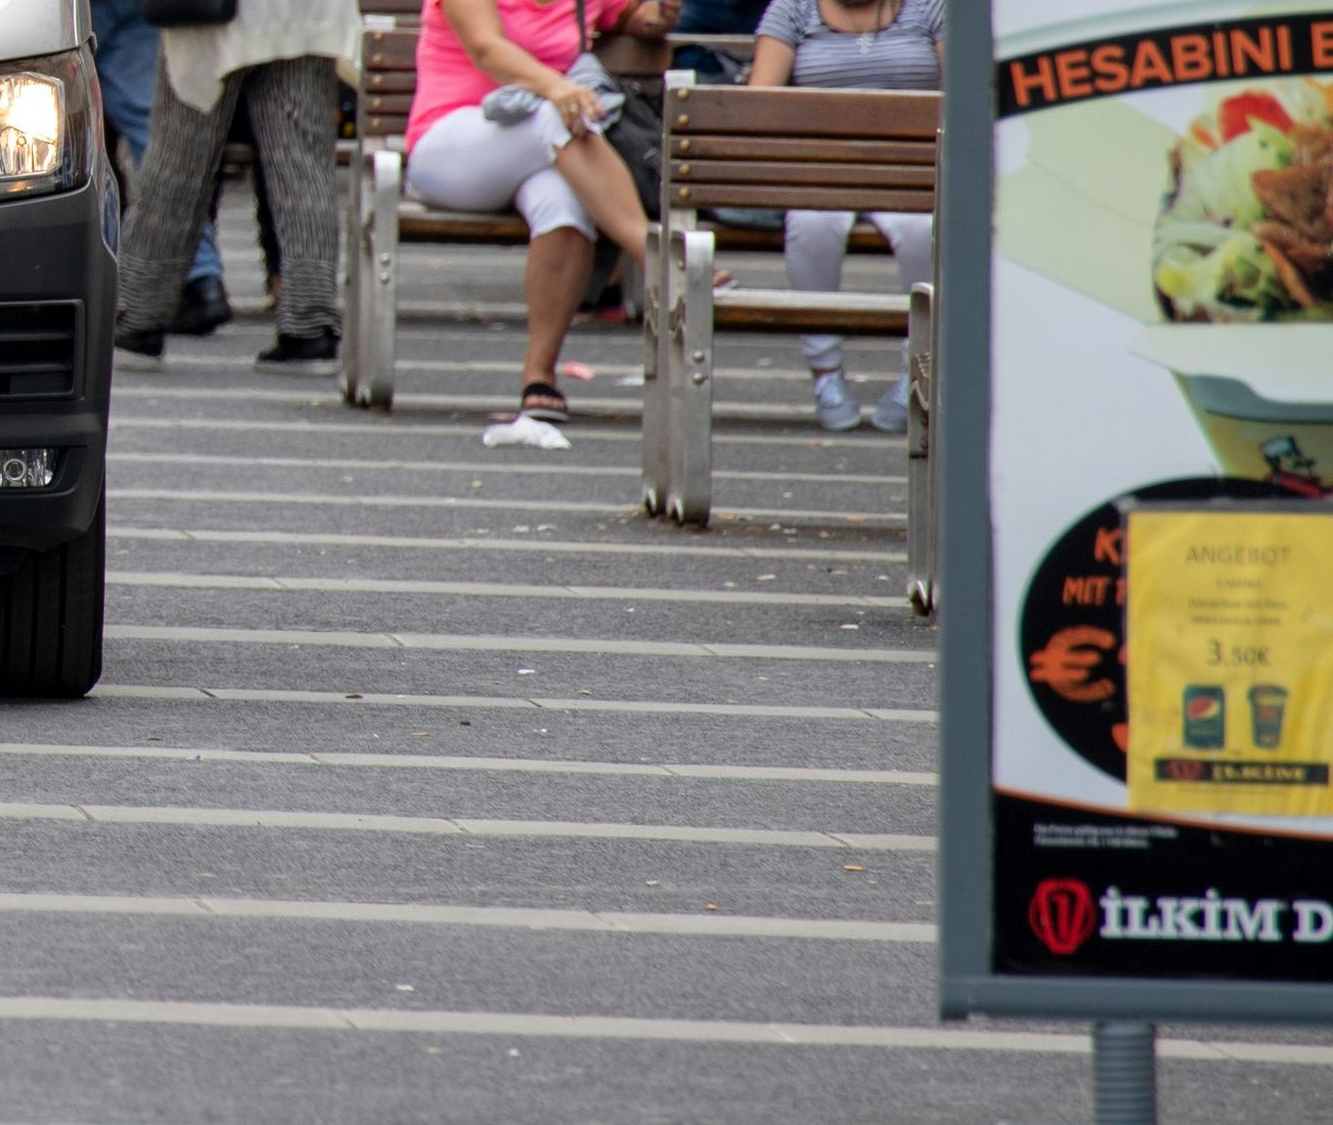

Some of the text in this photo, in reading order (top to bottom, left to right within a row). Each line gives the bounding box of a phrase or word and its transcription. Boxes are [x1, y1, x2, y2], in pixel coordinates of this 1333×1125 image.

[1010, 26, 1293, 107] HESABINI
[1185, 545, 1291, 566] ANGEBOT
[1062, 577, 1109, 606] MIT
